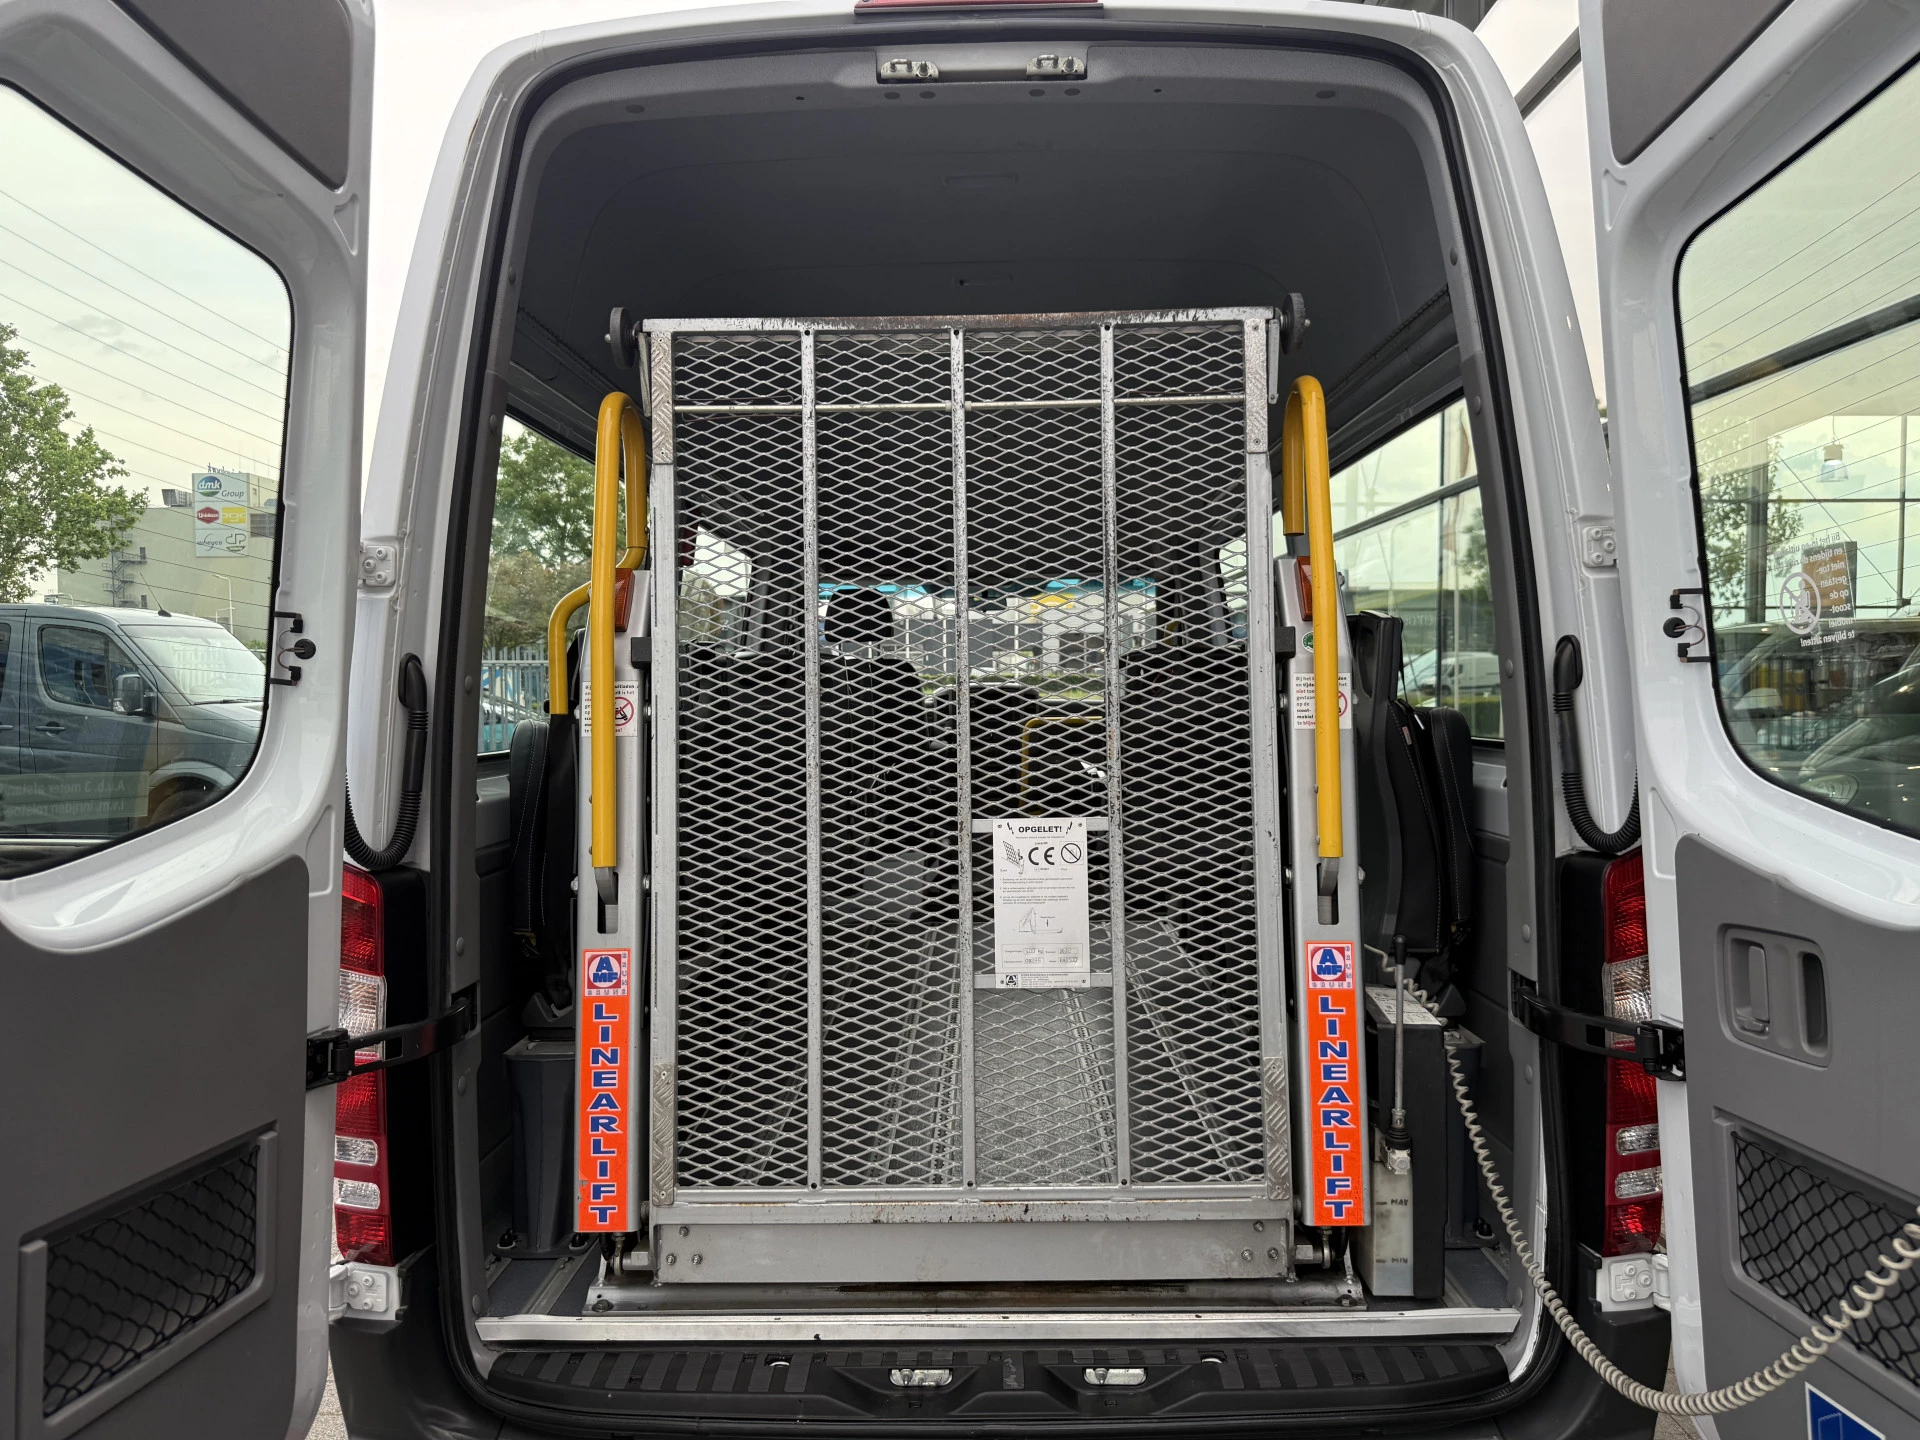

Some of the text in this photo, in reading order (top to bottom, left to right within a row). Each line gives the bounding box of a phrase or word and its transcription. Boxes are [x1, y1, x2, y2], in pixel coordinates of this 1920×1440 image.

[198, 480, 221, 490] dmk
[221, 489, 245, 499] Group
[1018, 825, 1062, 834] OPGELET!
[592, 956, 619, 983] AMF
[1316, 948, 1342, 975] AMF
[586, 1002, 623, 1226] LINEARLIFT
[1317, 995, 1356, 1219] LINEARLIFT
